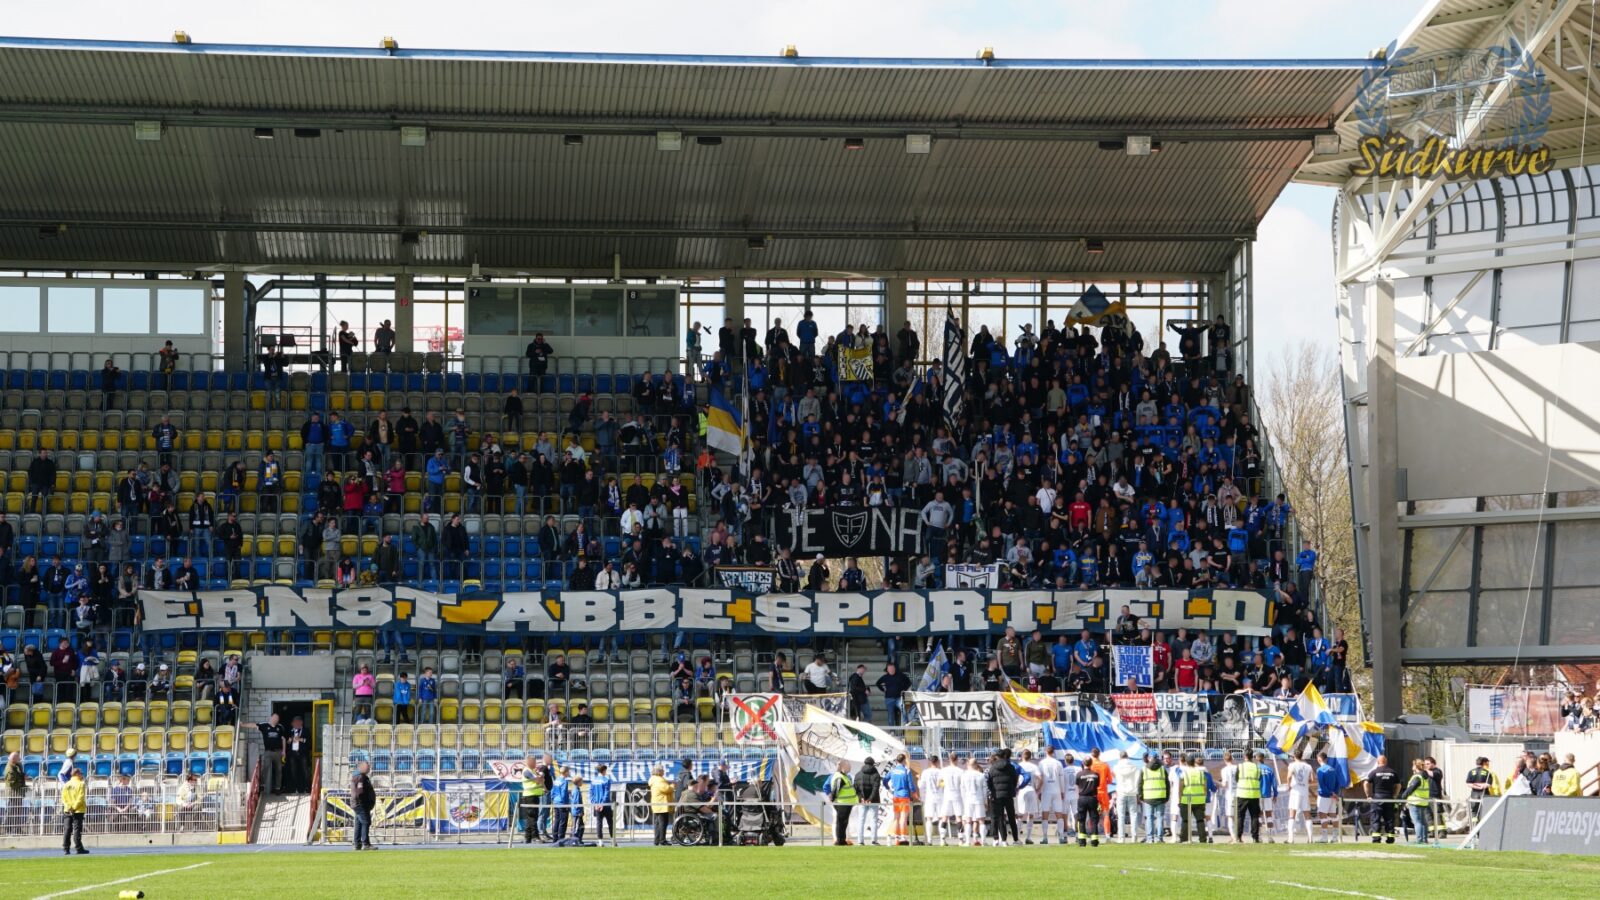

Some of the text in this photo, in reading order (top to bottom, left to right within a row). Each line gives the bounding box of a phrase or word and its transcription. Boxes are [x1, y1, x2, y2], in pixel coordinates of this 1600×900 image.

[472, 288, 479, 297] 7
[630, 290, 637, 299] 8
[947, 564, 965, 572] DIE
[138, 586, 1272, 636] ERNST ABBE SPORTFELD
[1119, 654, 1151, 666] ABBE
[1119, 665, 1151, 675] SPORT
[917, 701, 993, 721] ULTRAS
